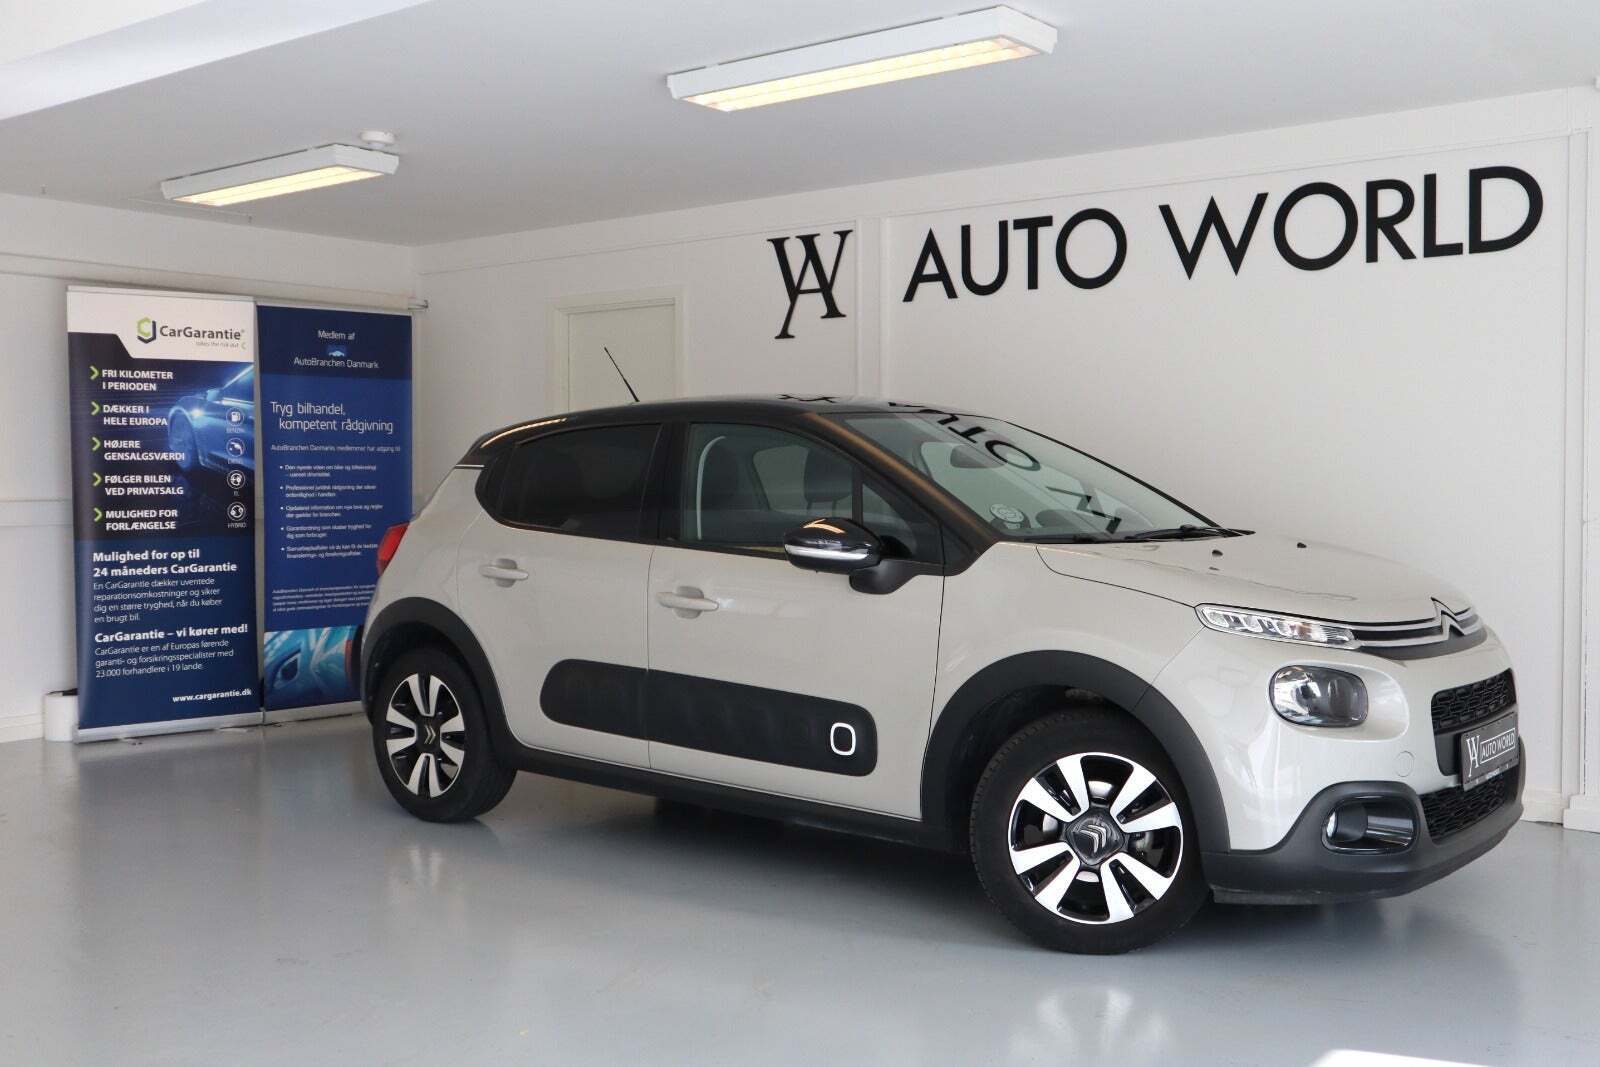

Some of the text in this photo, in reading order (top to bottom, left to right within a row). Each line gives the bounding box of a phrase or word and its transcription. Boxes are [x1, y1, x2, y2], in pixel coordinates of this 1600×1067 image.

[902, 165, 1544, 304] AUTO WORLD
[160, 325, 241, 341] CarGarantie
[318, 330, 355, 340] Medlem af
[294, 356, 379, 369] AutoBranchen Danmark
[102, 369, 173, 380] FRI KILOMETER
[102, 382, 157, 391] I PERIODEN
[103, 405, 149, 414] DÆKKER I
[270, 401, 346, 417] Tryg bilhandel,
[103, 417, 168, 426] HELE EUROPA
[279, 418, 394, 434] kompetent rådgivning
[104, 440, 140, 449] HØJERE
[104, 452, 185, 461] GENSALGSVÆRDI
[104, 475, 171, 484] FØLGER BILEN
[105, 487, 184, 496] VED PRIVATSALG
[106, 510, 178, 519] MULIGHED FOR
[106, 521, 176, 531] FORLÆNGELSE
[93, 549, 200, 563] Mulighed for op til
[93, 562, 237, 577] 24 måneders CarGarantie
[105, 580, 150, 589] CarGarantie
[151, 579, 179, 587] dækker
[181, 578, 215, 586] uventede
[94, 590, 188, 601] reparationsomkostninger
[94, 605, 107, 613] dig
[120, 603, 142, 611] større
[190, 599, 200, 607] du
[201, 598, 222, 606] køber
[106, 614, 127, 624] brugt
[94, 629, 165, 643] CarGarantie
[176, 627, 186, 637] vi
[189, 626, 218, 636] kører
[221, 624, 248, 634] med!
[94, 645, 140, 656] CarGarantie
[162, 643, 169, 651] af
[170, 642, 200, 651] Europas
[201, 639, 229, 648] førende
[95, 649, 234, 668] garanti- og forsikringsspecialister med
[95, 669, 121, 678] 23.000
[122, 665, 166, 675] forhandlere
[172, 688, 252, 703] www.cargarantie.dk
[1481, 733, 1515, 760] AUTO WORLD
